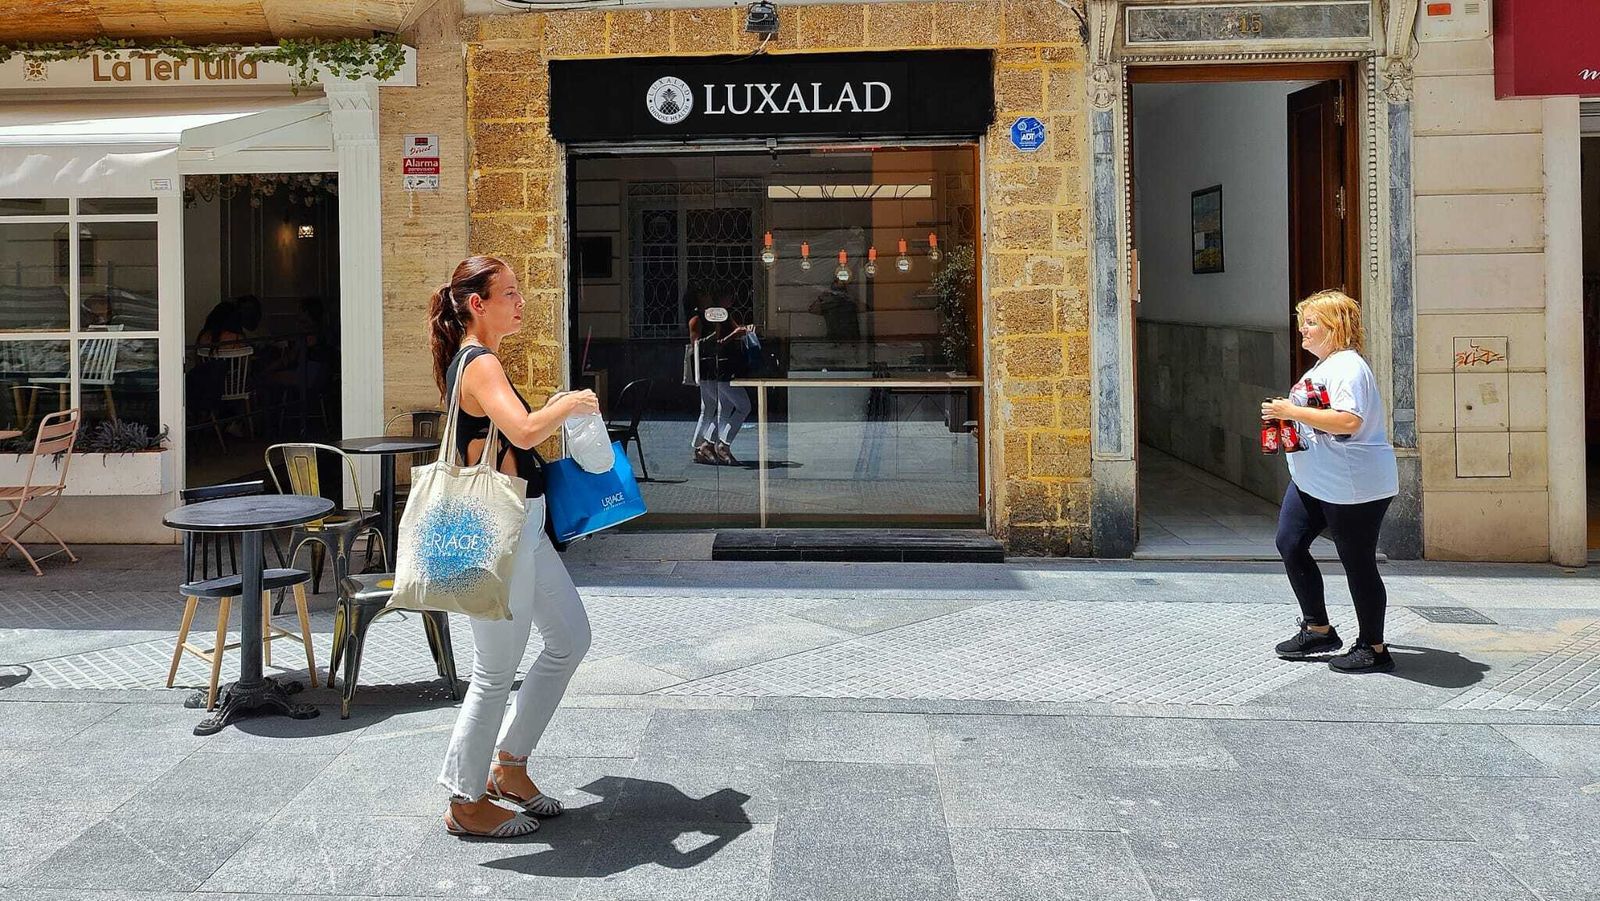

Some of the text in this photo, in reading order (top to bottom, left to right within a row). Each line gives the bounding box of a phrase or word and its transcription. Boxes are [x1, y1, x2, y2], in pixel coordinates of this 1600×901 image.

[1239, 14, 1263, 33] 15
[92, 54, 132, 82] La
[648, 78, 690, 97] LUXALAD
[703, 81, 892, 115] LUXALAD
[649, 104, 690, 122] CHOOSE HEALTH
[1022, 133, 1035, 141] ADT
[405, 158, 439, 168] Alarma
[601, 492, 625, 508] URIAGE
